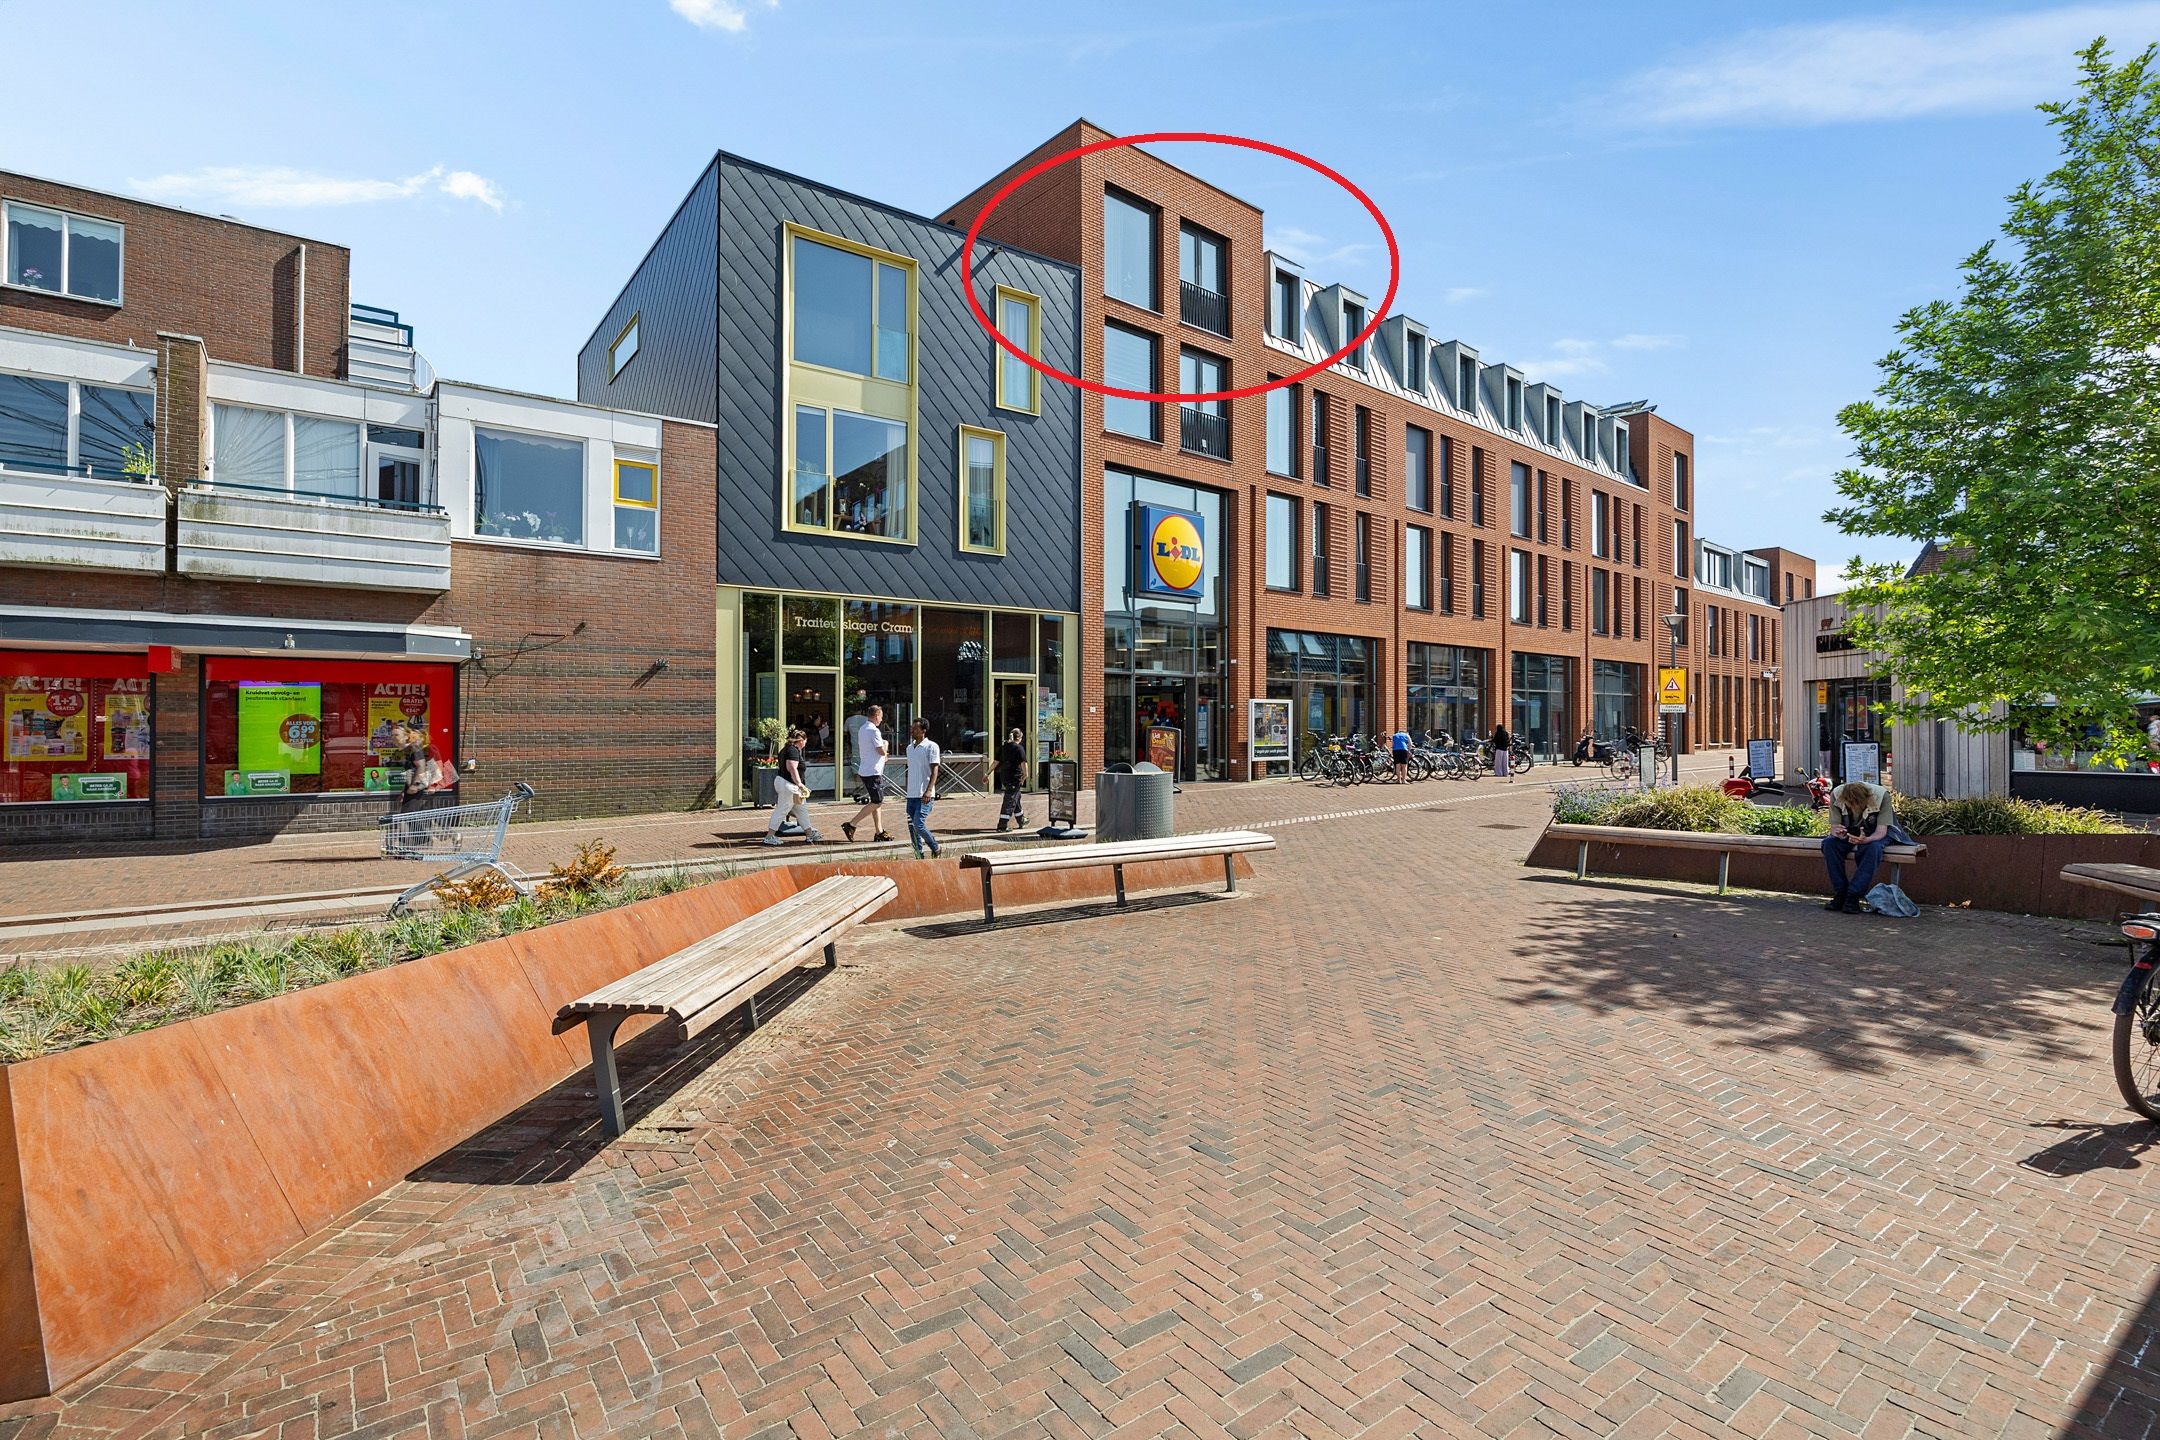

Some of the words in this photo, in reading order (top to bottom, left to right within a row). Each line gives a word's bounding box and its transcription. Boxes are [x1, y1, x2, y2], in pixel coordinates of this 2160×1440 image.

[794, 616, 879, 633] Traiteuslager
[881, 621, 922, 633] Cram
[12, 676, 82, 691] ACTIE!
[374, 682, 426, 696] ACTIE!
[53, 695, 78, 706] 1+1
